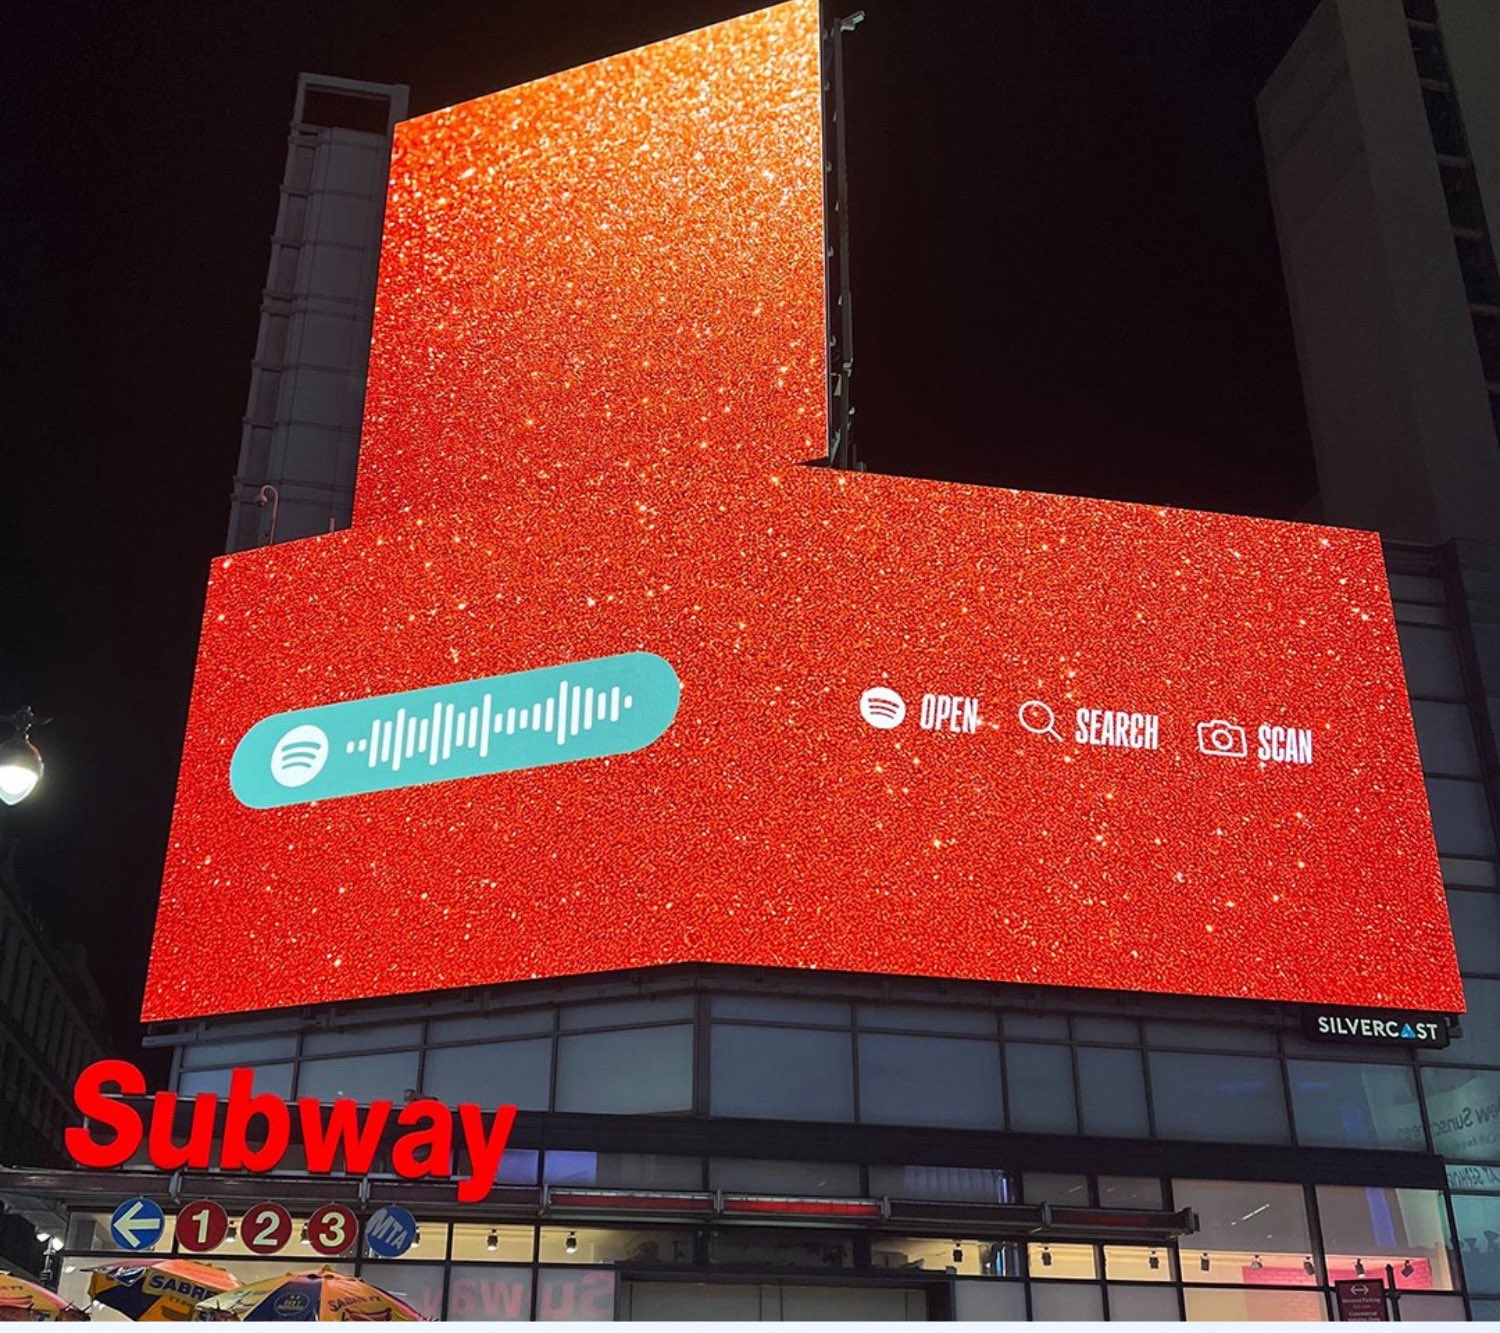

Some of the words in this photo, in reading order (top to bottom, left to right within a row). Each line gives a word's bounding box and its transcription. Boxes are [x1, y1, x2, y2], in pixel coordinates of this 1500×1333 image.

[919, 692, 980, 734] OPEN
[1074, 708, 1159, 751] SEARCH
[1257, 723, 1313, 765] SCAN
[1317, 1016, 1438, 1041] SILVERCAST
[64, 1060, 518, 1203] Subway
[191, 1209, 211, 1243] 1
[252, 1210, 280, 1246] 2
[318, 1212, 346, 1247] 3
[366, 1207, 408, 1249] MTA
